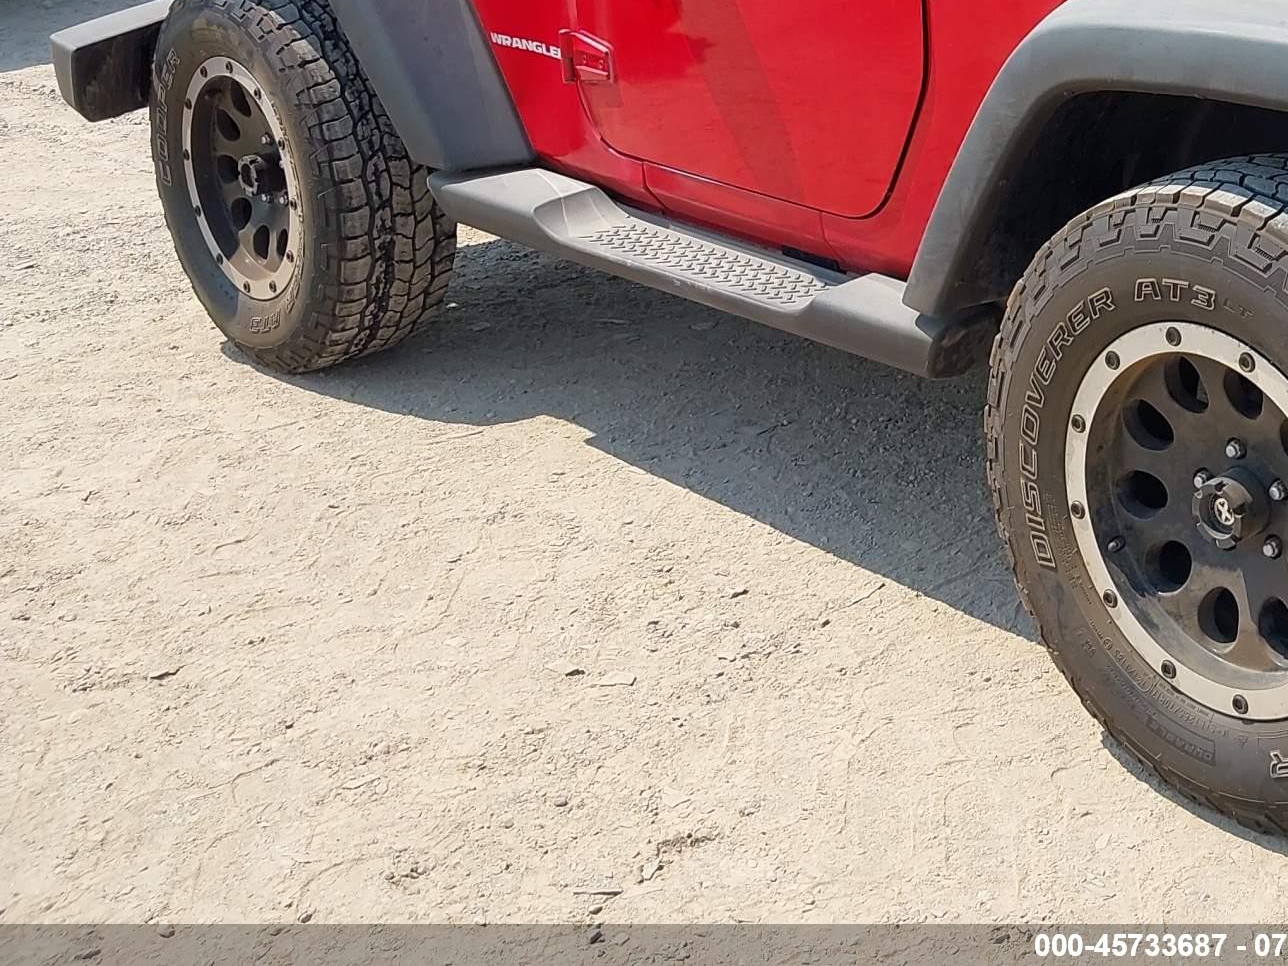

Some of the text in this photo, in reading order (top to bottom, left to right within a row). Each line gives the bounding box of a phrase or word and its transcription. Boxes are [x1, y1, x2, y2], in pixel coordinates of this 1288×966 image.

[157, 48, 180, 186] COOPER
[1019, 288, 1115, 568] DISCOVERER
[1134, 278, 1215, 310] AT3
